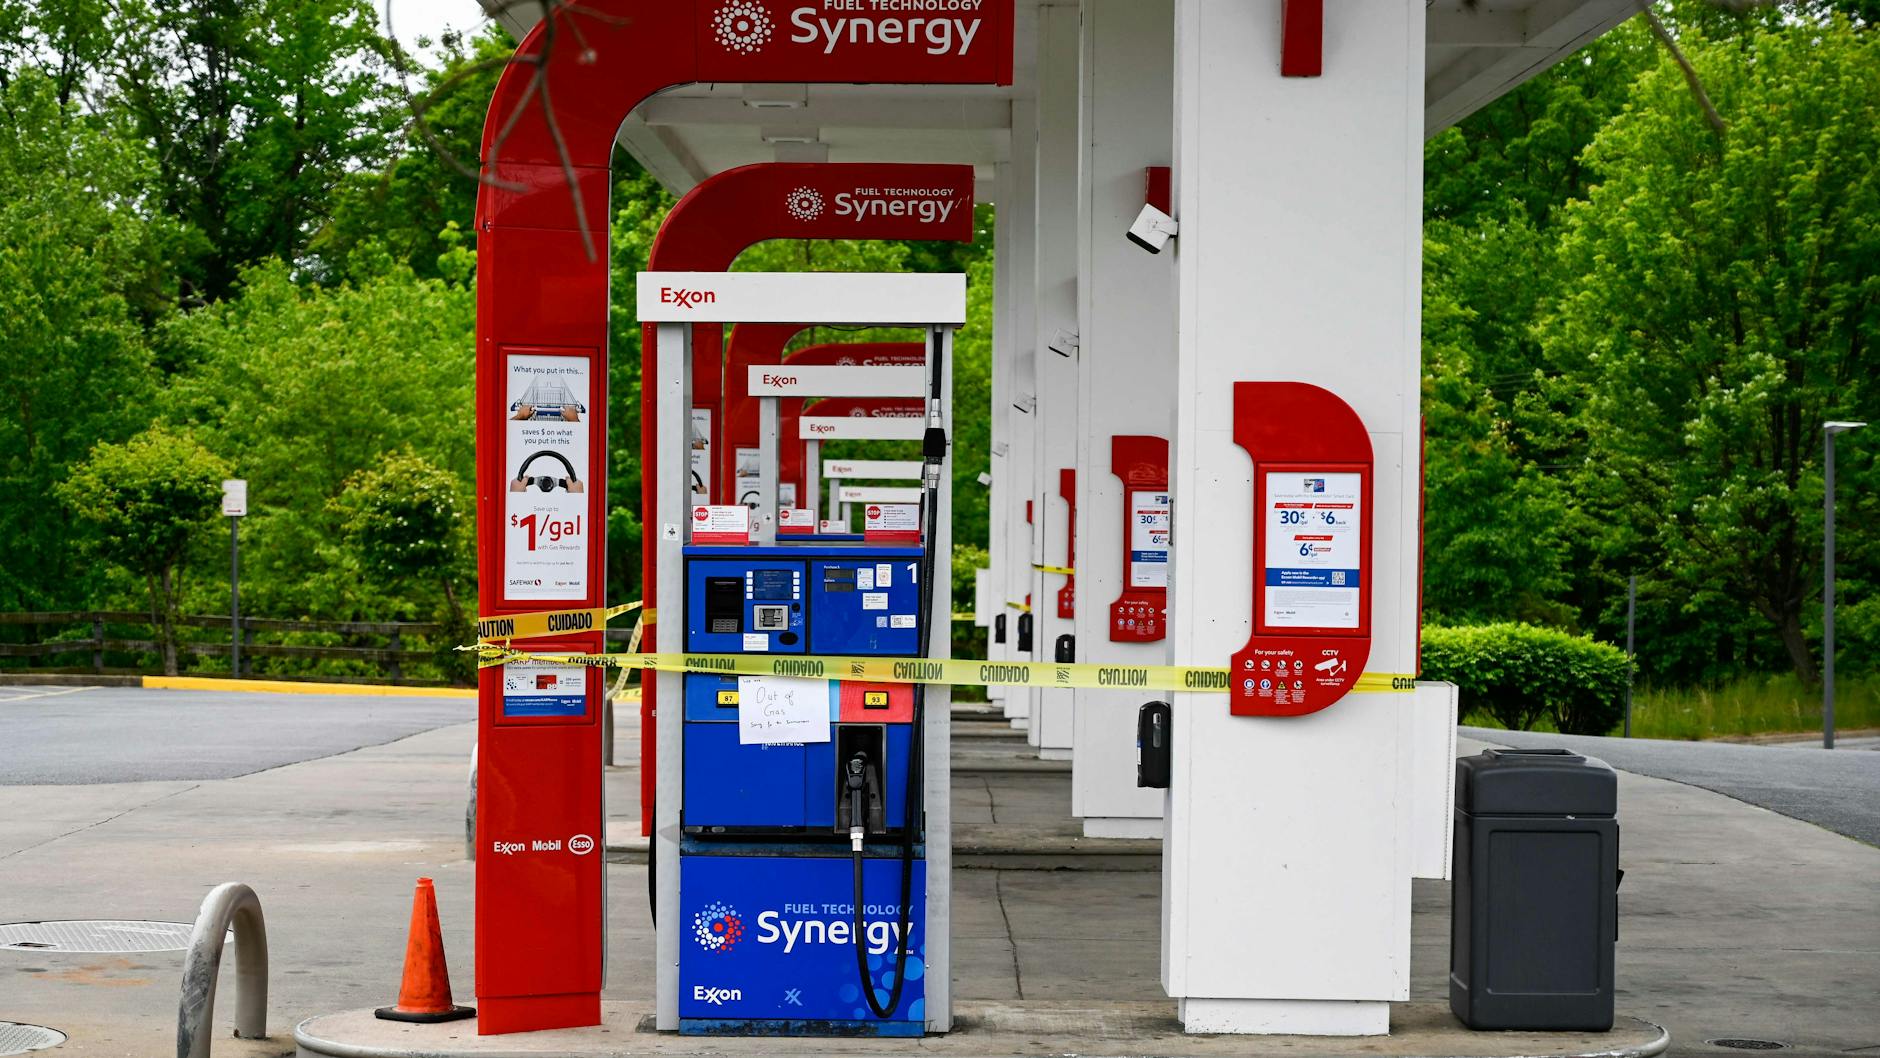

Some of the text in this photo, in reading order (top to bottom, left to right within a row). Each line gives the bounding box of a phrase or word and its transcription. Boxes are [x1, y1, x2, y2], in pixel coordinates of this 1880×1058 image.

[824, 0, 982, 11] FUEL TECHNOLOGY
[791, 7, 982, 55] Synergy
[855, 188, 954, 197] FUEL TECHNOLOGY
[835, 193, 954, 223] Synergy
[661, 288, 716, 309] Exxon
[513, 365, 532, 373] What
[533, 367, 545, 375] you
[763, 374, 797, 388] Exxon
[521, 429, 540, 437] saves
[541, 428, 546, 437] $
[556, 429, 573, 438] what
[810, 424, 835, 434] Exxon
[524, 437, 570, 446] you put in this
[906, 562, 917, 584] 1
[478, 612, 593, 638] AUTION CUIDADO
[1277, 649, 1294, 657] safety
[756, 686, 778, 704] Out
[763, 703, 786, 717] Gas
[494, 840, 591, 856] Exxon Mobil Esso
[784, 903, 818, 914] FUEL
[694, 985, 742, 1006] Exxon
